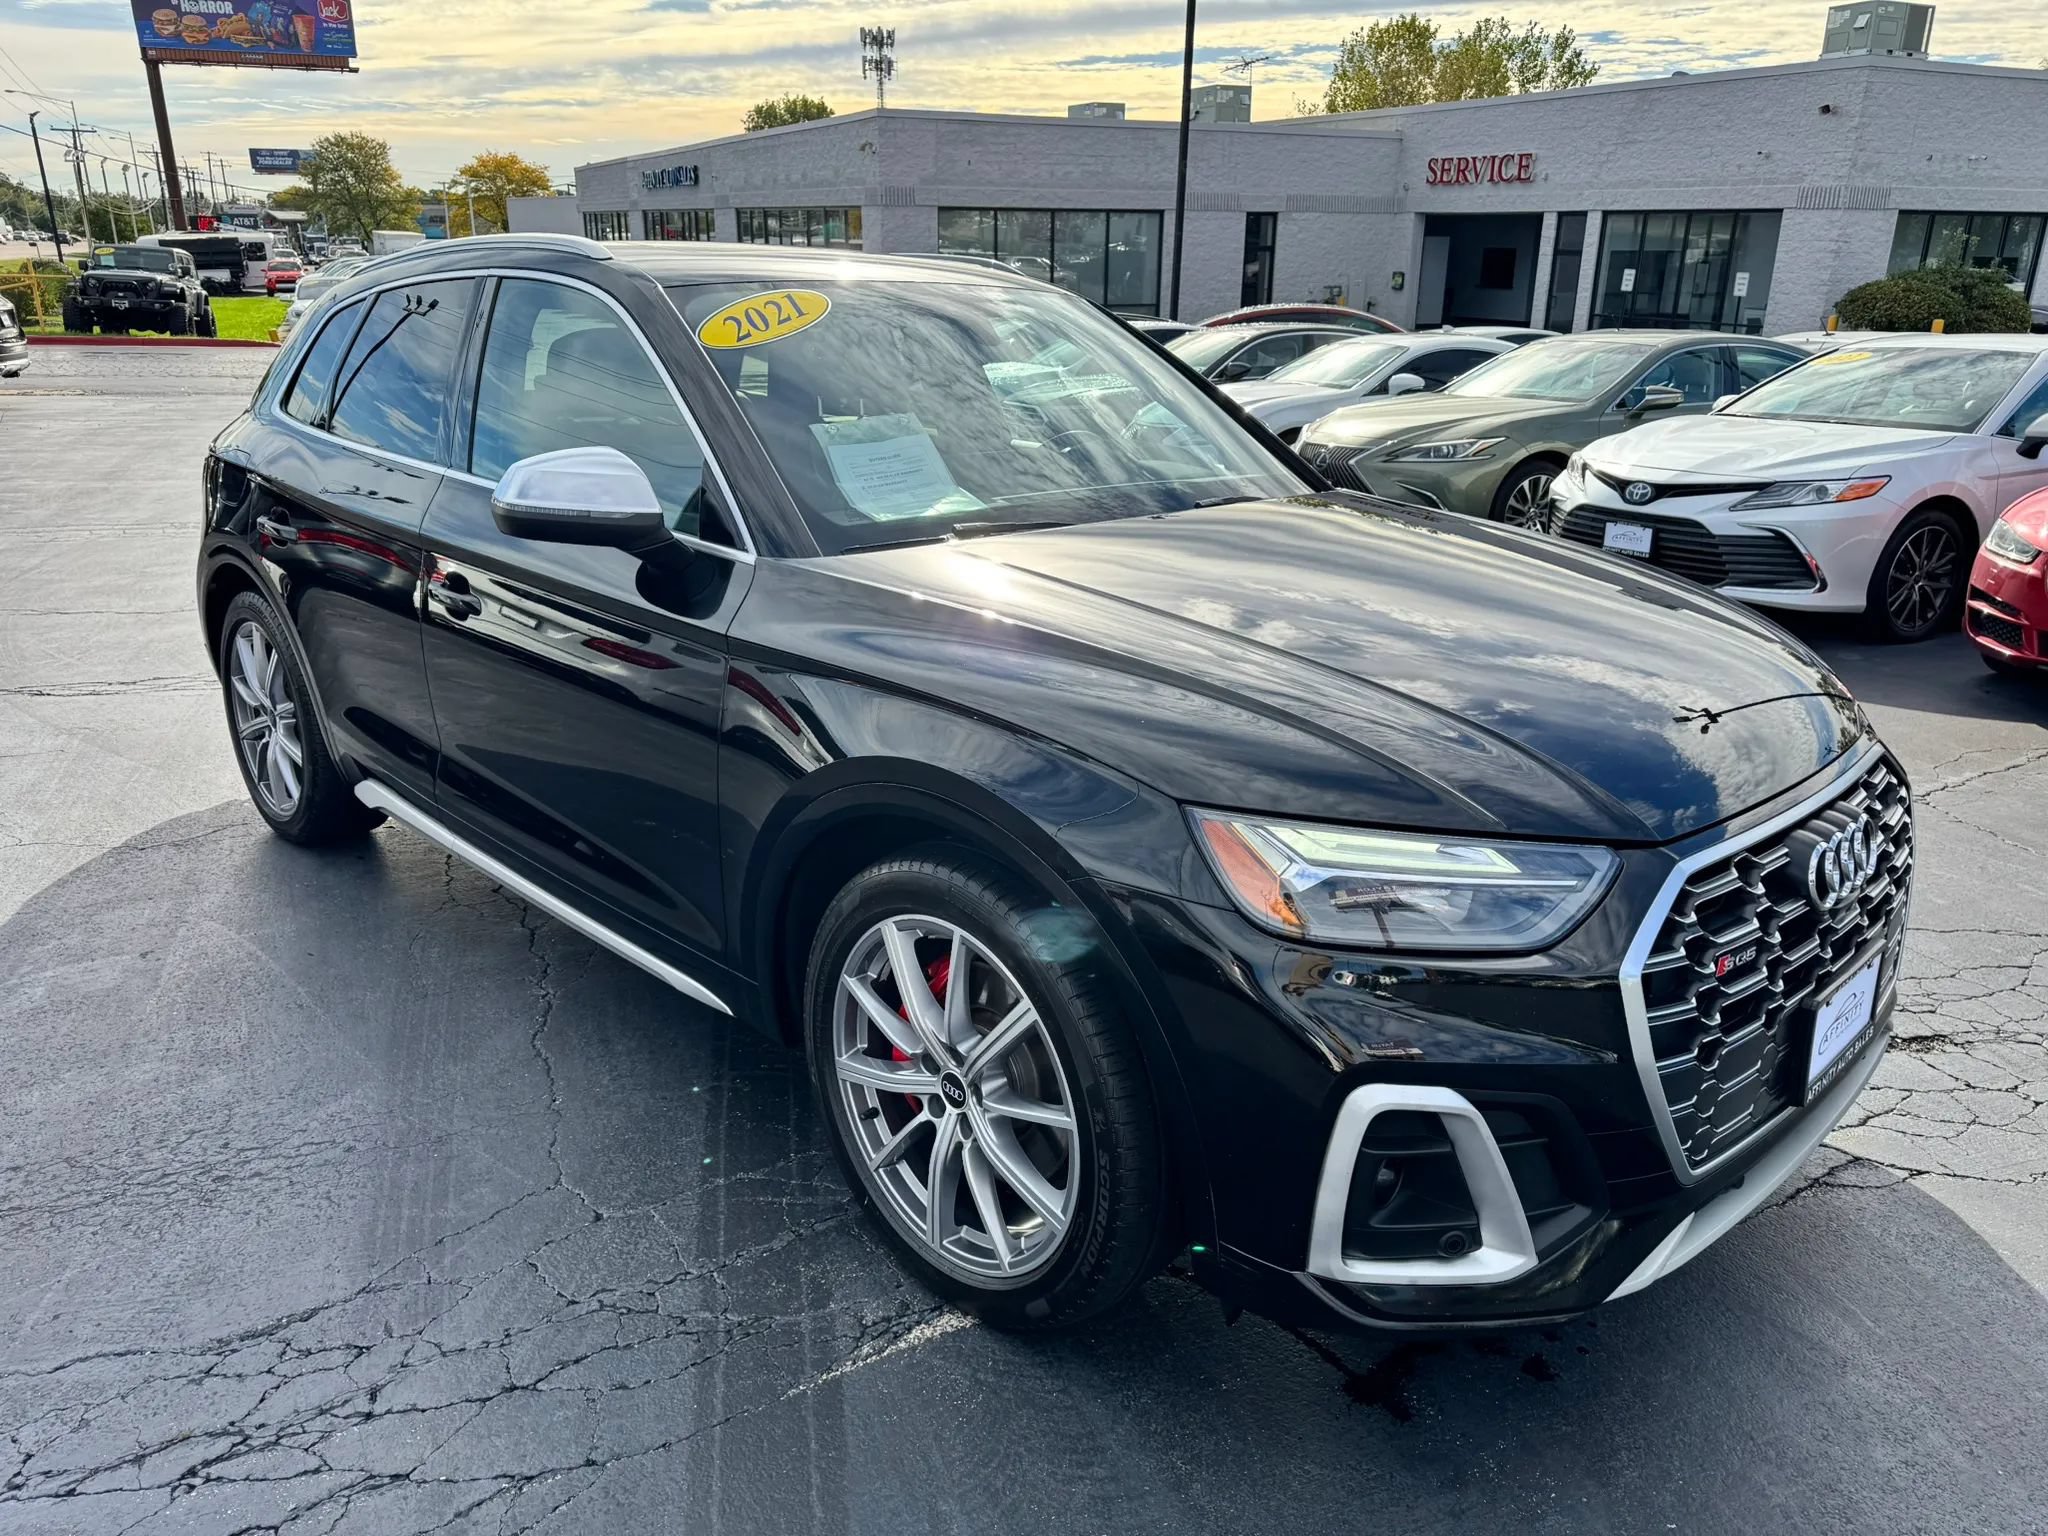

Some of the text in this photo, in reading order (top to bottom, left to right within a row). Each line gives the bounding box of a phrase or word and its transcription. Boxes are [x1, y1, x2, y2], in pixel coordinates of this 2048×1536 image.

[320, 0, 347, 19] Jack
[1426, 153, 1534, 184] SERVICE
[233, 217, 255, 226] AT&T
[722, 293, 809, 343] 2021
[1718, 946, 1757, 973] SQ5
[1823, 1000, 1865, 1045] AFFINITY
[1806, 1062, 1838, 1103] AFFINITY
[1837, 1048, 1854, 1070] AUTO
[1854, 1026, 1875, 1055] SALES
[1079, 1148, 1111, 1280] SCORPION
